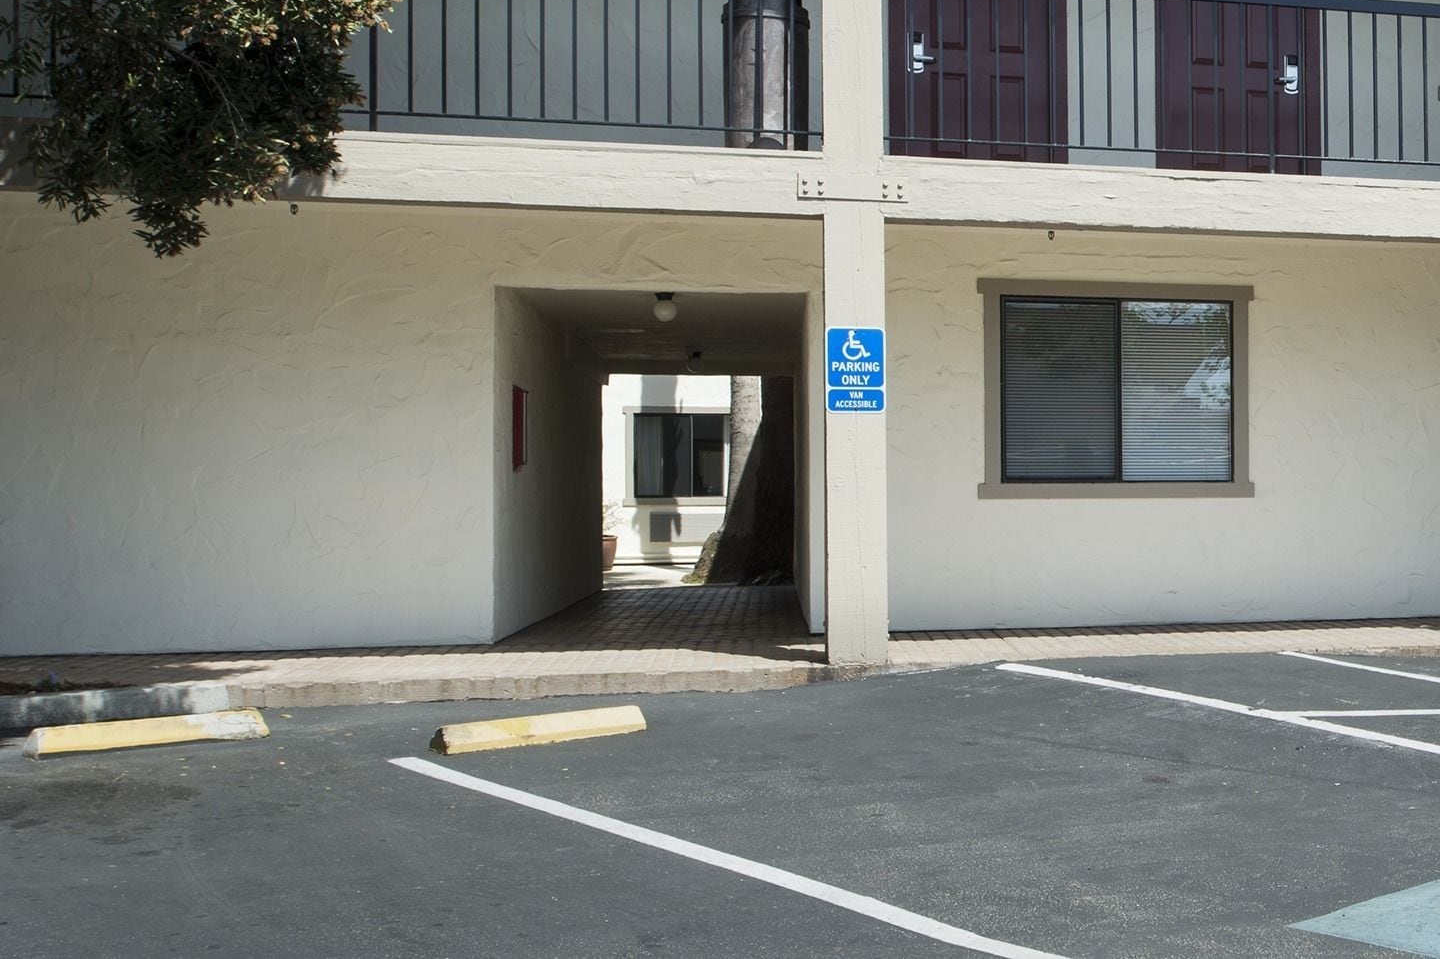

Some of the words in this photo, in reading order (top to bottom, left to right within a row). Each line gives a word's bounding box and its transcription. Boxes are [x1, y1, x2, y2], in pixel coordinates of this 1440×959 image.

[831, 361, 880, 372] PARKING
[841, 374, 871, 385] ONLY
[849, 391, 864, 399] VAN
[835, 400, 878, 408] ACCESSIBLE
